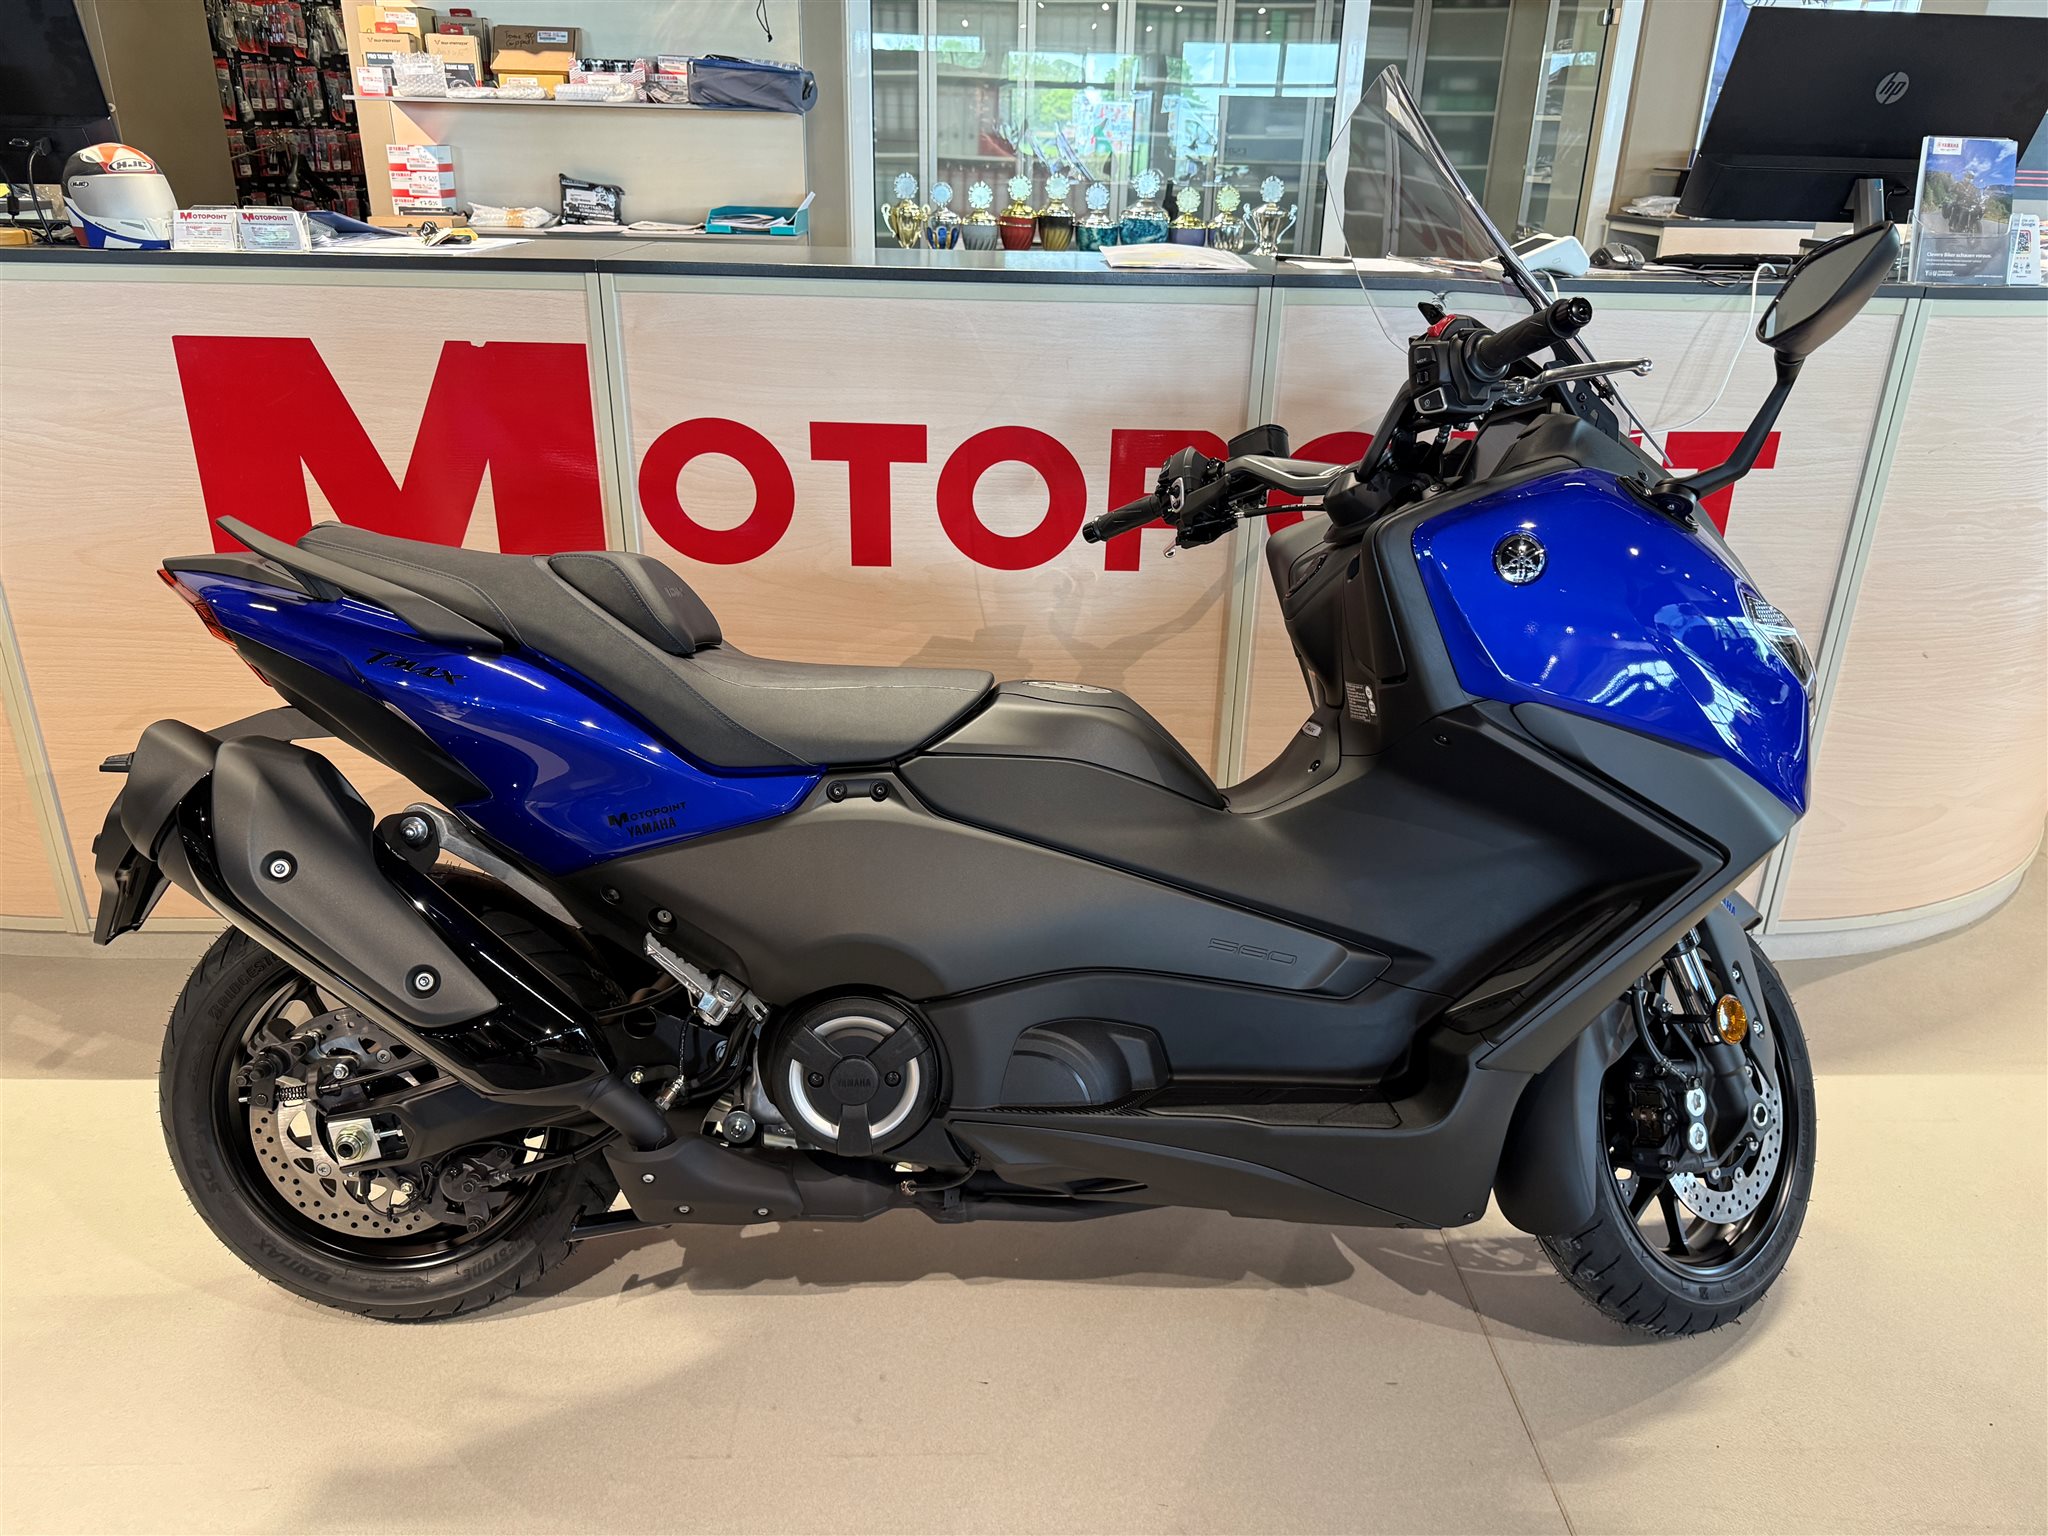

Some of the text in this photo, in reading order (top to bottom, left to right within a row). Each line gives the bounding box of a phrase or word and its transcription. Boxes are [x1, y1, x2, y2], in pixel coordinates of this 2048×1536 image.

[1878, 72, 1907, 104] hp
[116, 160, 148, 170] HJC
[180, 212, 228, 221] MOTOPOINT
[241, 213, 288, 222] MOTOPOINT
[607, 802, 687, 828] MOTOPOINT
[627, 816, 677, 839] YAMAHA
[836, 1077, 872, 1089] YAMAHA
